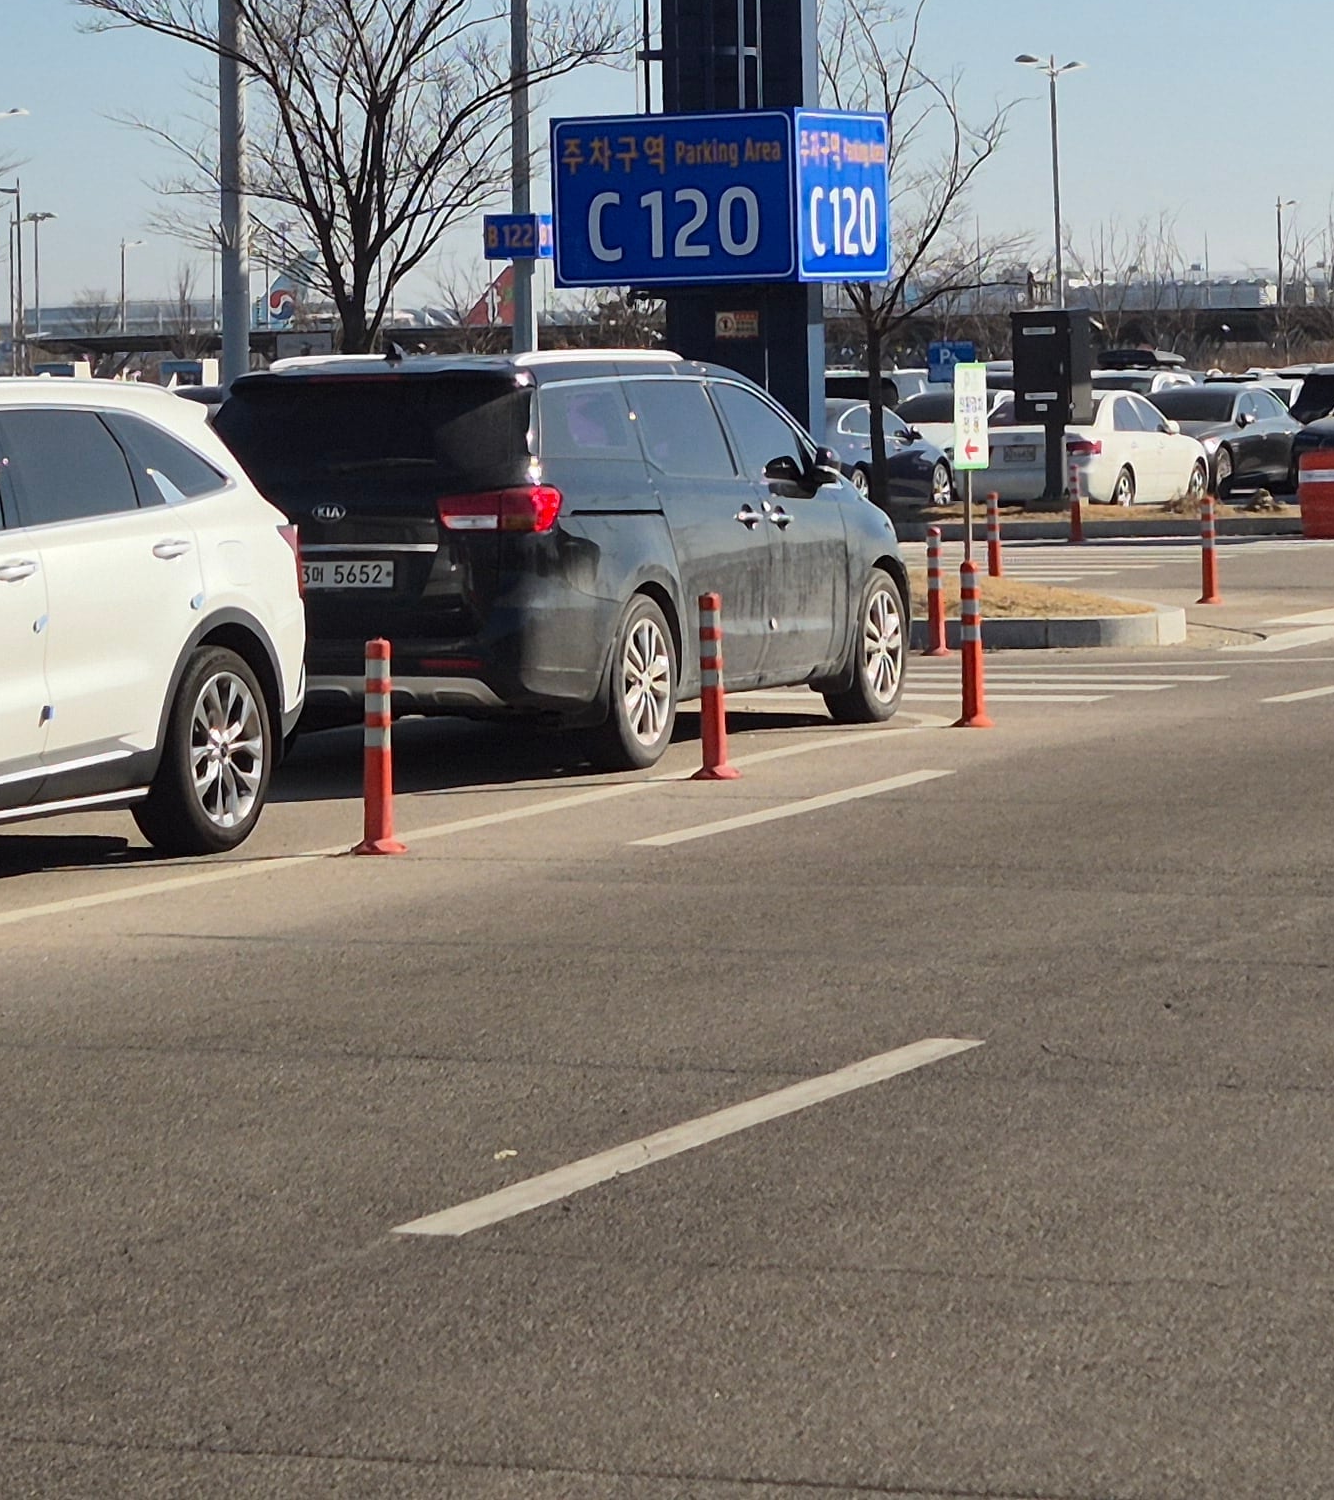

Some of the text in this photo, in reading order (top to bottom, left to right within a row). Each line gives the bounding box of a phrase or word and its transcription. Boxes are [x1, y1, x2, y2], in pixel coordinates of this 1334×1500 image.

[561, 134, 782, 175] 주차구역 Parking Area
[487, 225, 499, 248] B
[502, 224, 533, 248] 122
[588, 186, 760, 262] C 120
[810, 186, 876, 257] C 120
[317, 506, 341, 518] KIA
[333, 563, 383, 584] 5652
